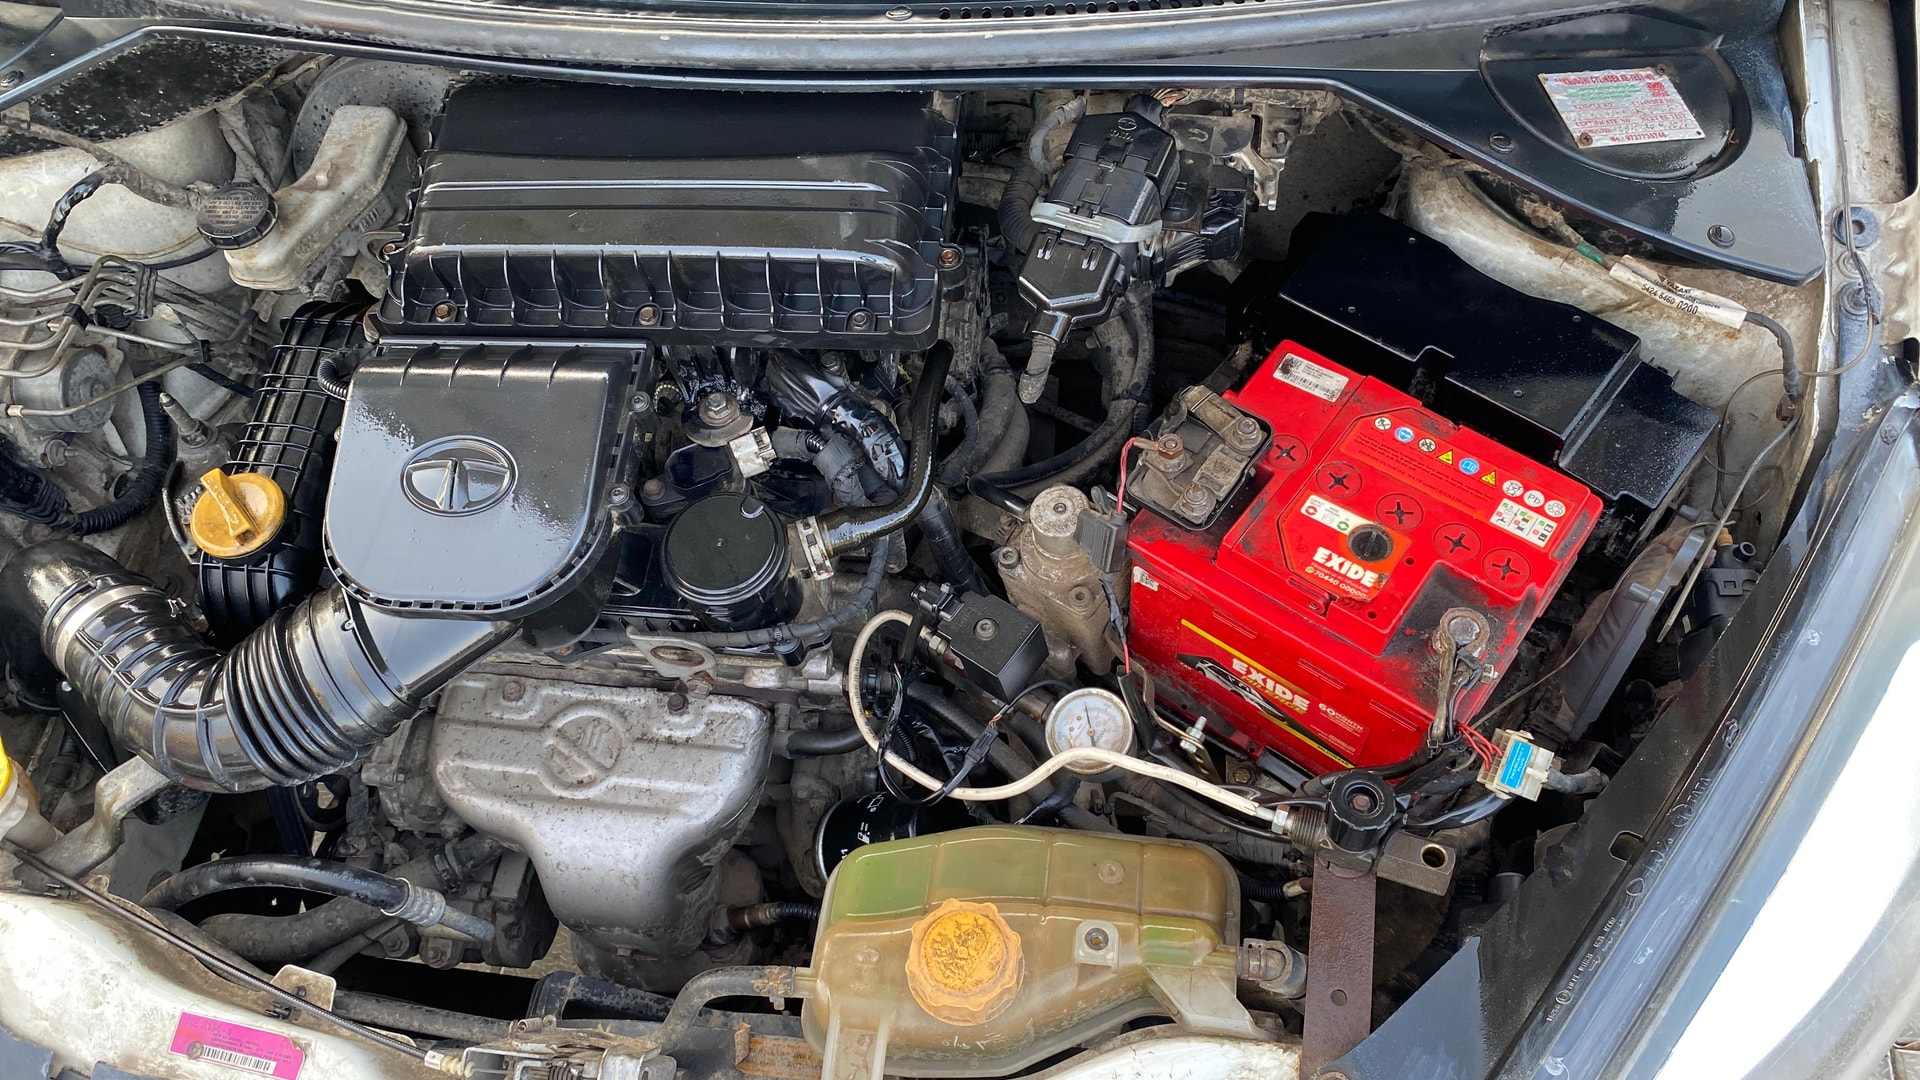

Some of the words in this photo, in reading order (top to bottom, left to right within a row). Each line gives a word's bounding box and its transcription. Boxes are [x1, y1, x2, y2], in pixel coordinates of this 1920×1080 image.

[1640, 283, 1658, 297] 5424
[1676, 300, 1699, 314] 0200
[1666, 279, 1692, 294] YAZAKI
[1527, 493, 1541, 504] Pb
[1312, 546, 1380, 588] EXIDE
[1314, 570, 1340, 586] 70440
[1344, 577, 1369, 594] WhatsApp
[1232, 658, 1311, 711] EXIDE
[1241, 674, 1308, 716] MILEAGE
[1687, 777, 1713, 803] TATA
